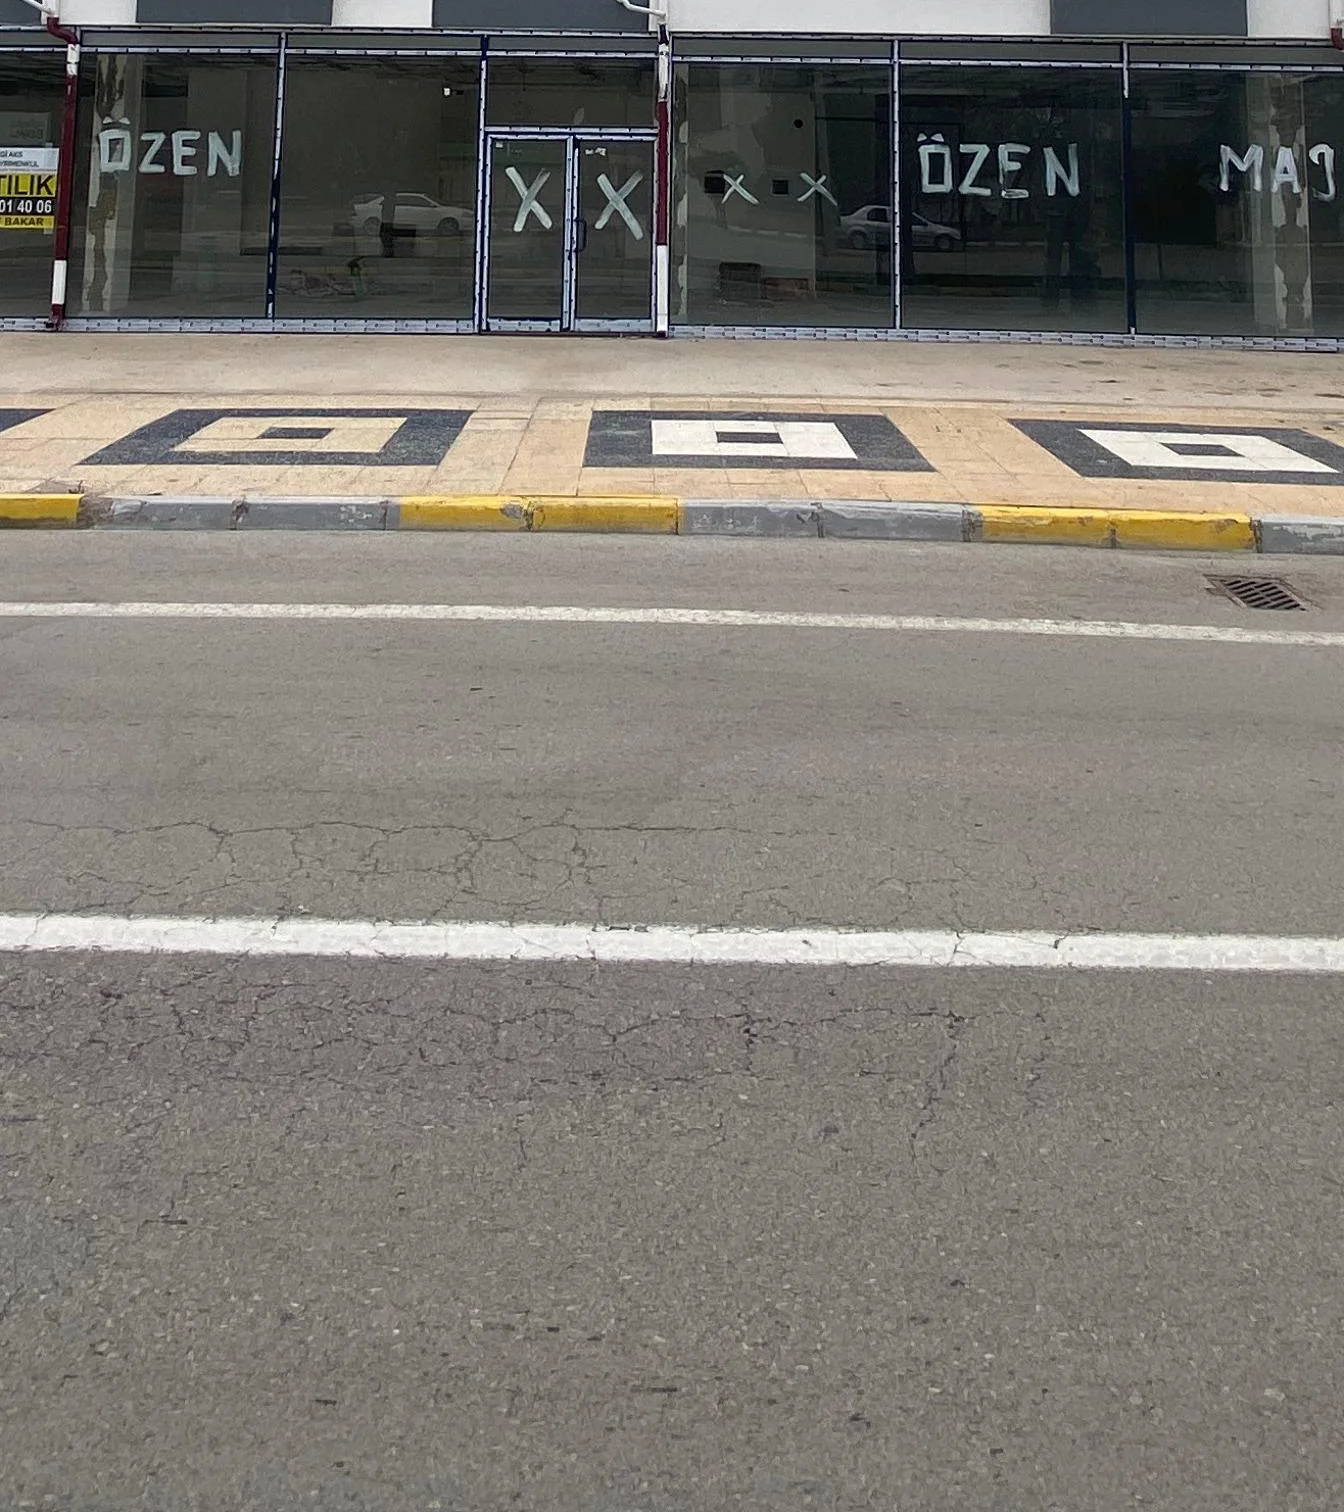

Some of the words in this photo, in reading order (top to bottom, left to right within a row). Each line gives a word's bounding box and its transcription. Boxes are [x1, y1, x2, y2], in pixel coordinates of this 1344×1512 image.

[98, 116, 242, 177] ÖZEN
[917, 133, 1081, 199] ÖZEN
[5, 217, 44, 226] BAKAR
[17, 199, 33, 213] 40
[36, 200, 52, 214] 06
